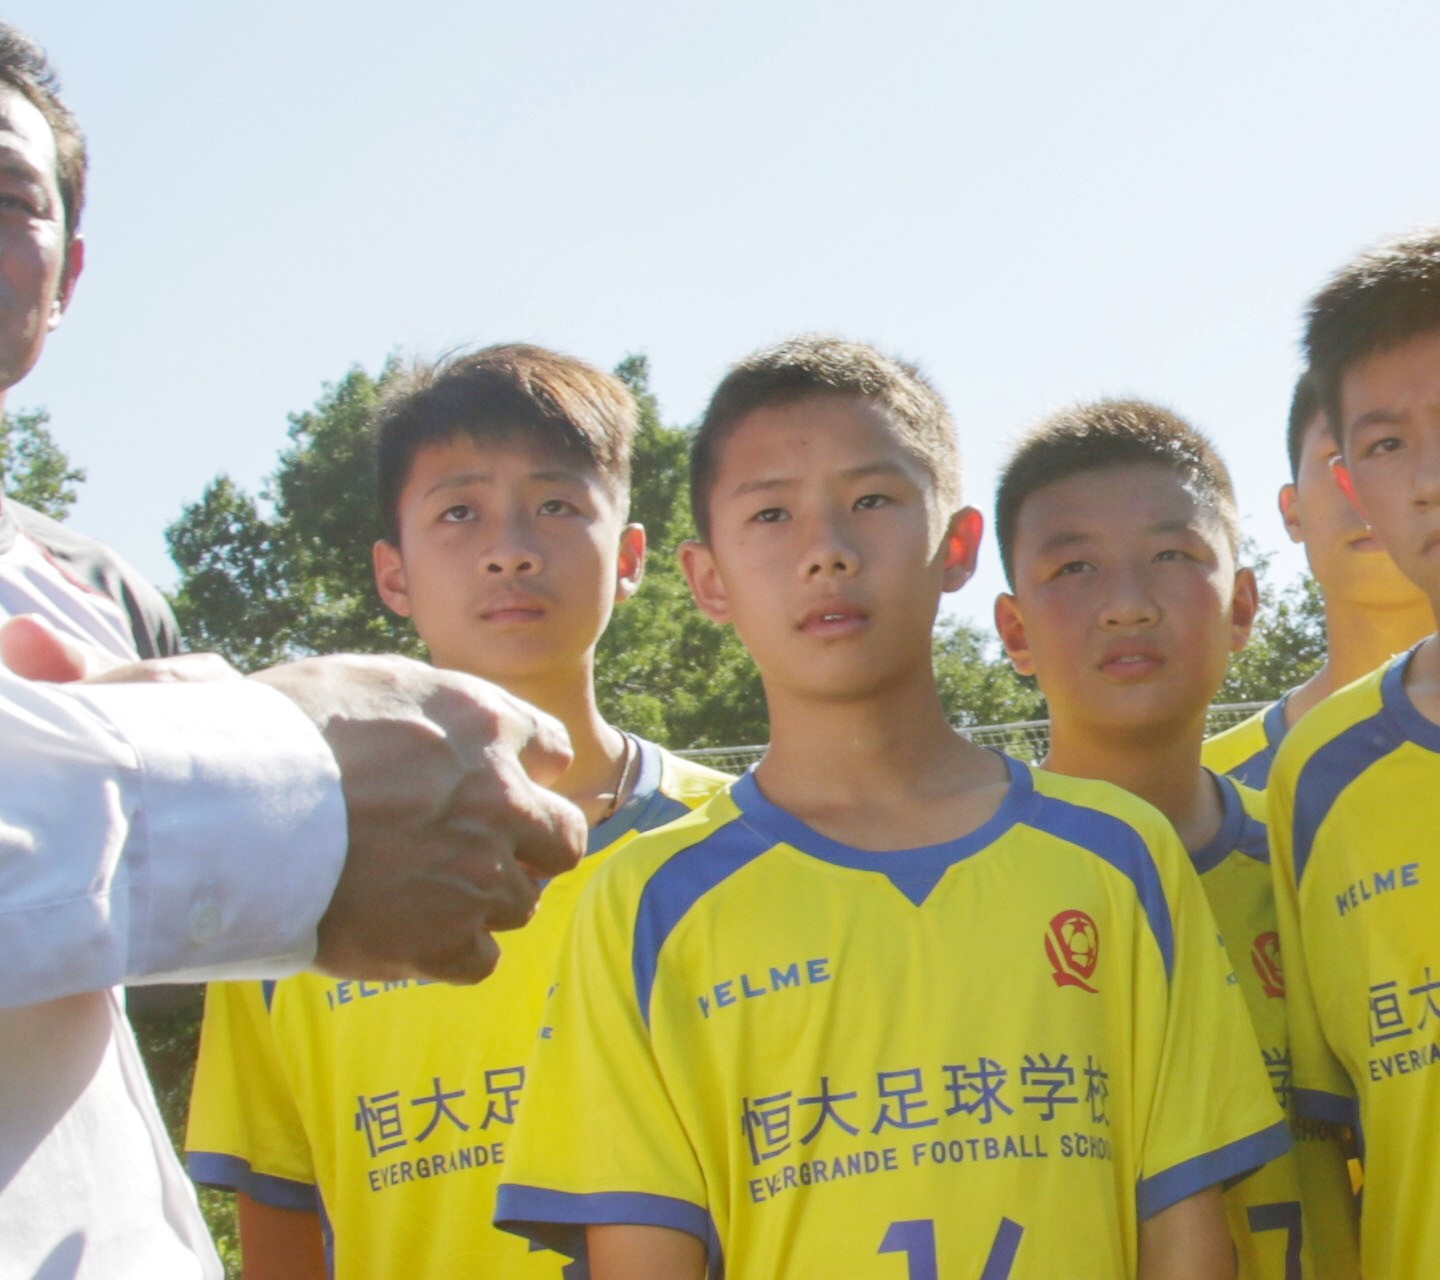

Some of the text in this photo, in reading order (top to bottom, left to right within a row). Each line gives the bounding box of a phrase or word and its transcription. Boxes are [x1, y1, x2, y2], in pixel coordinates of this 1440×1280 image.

[1336, 862, 1420, 917] KELME
[741, 1053, 1109, 1166] 恒大足球学校
[912, 1134, 1048, 1166] FOOTBALL
